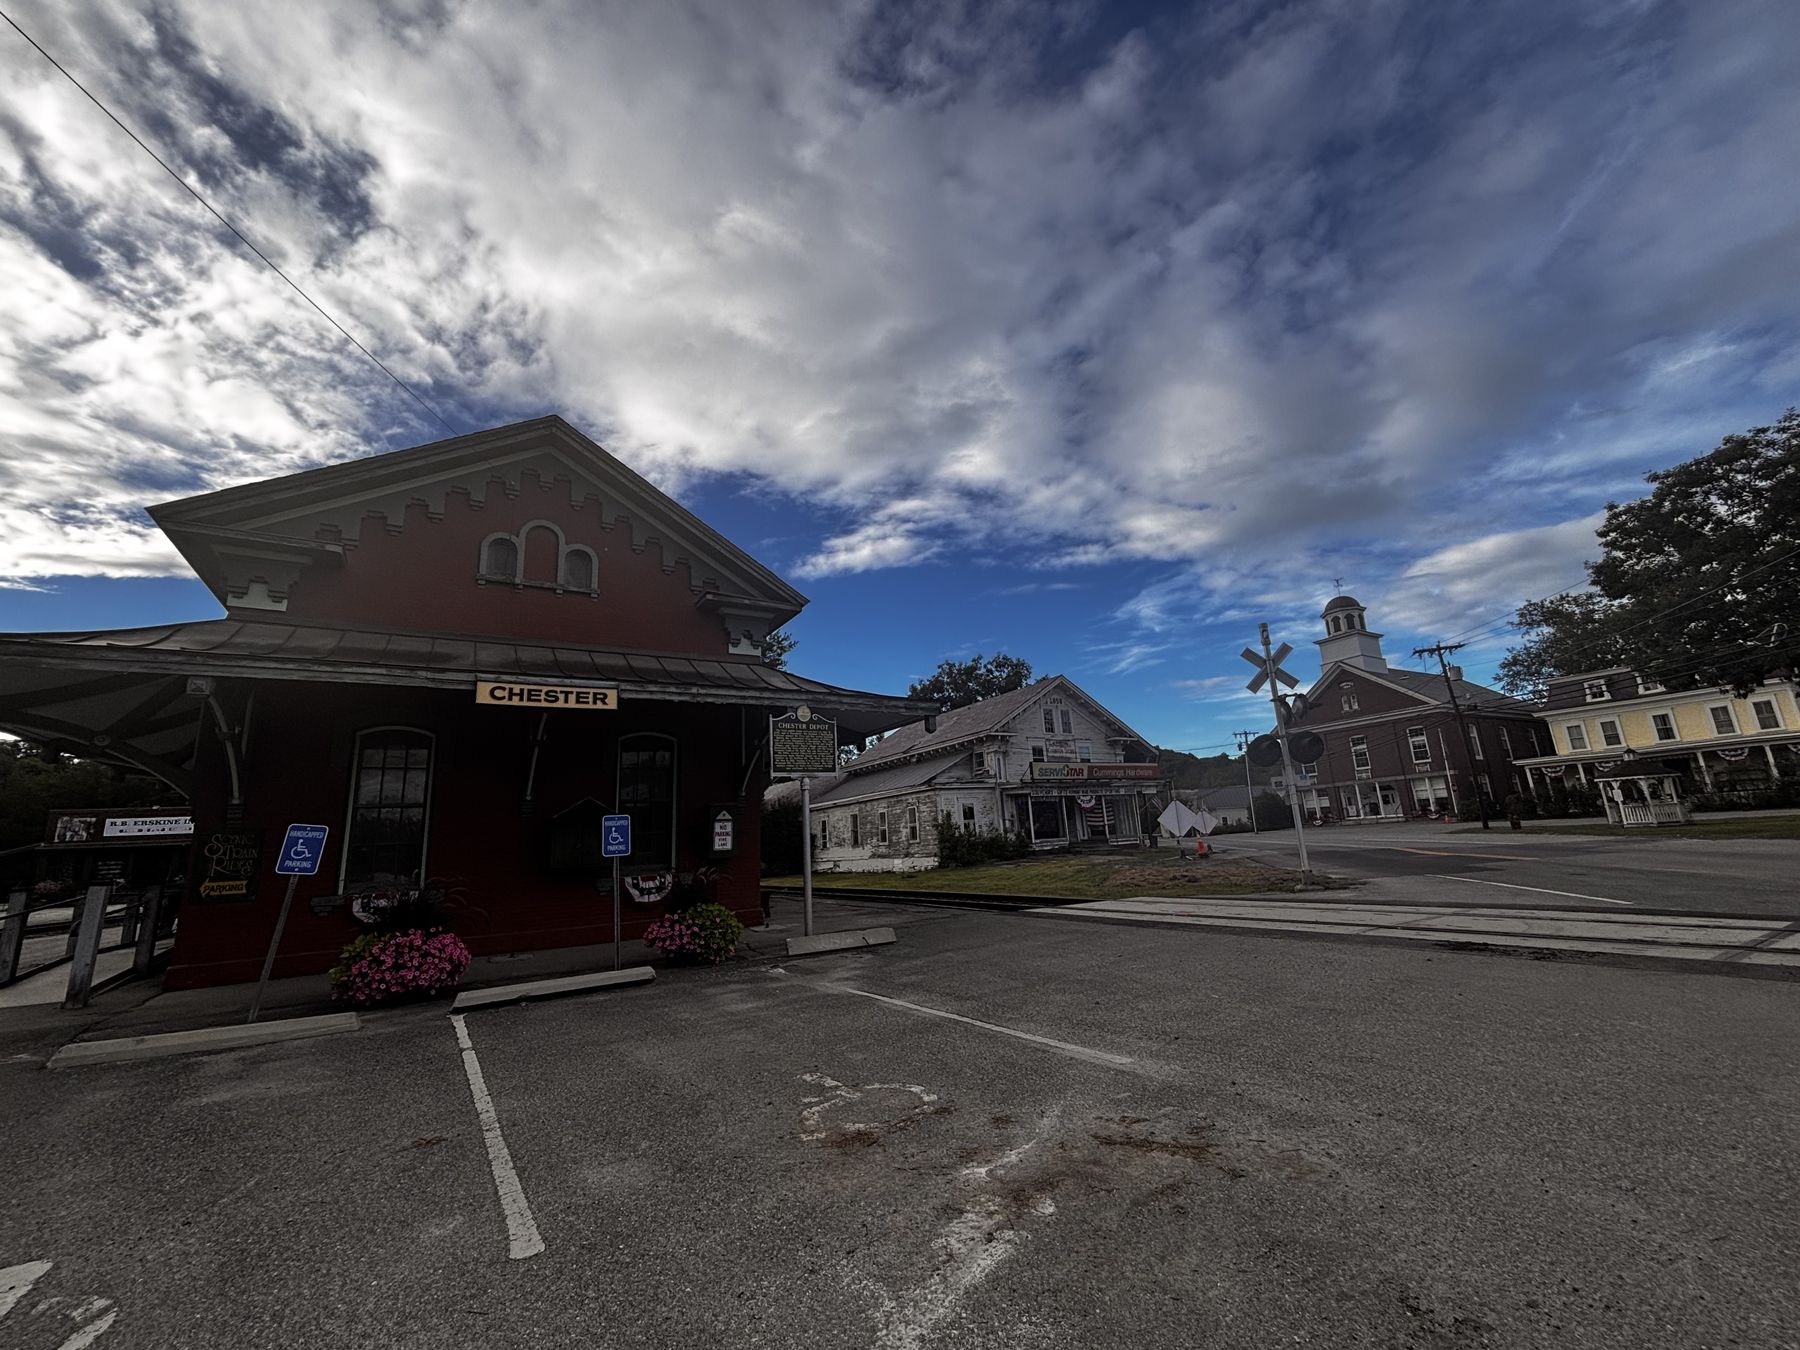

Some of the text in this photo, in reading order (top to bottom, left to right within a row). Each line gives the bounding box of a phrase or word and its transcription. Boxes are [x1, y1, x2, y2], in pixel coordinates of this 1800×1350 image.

[489, 686, 608, 705] CHESTER
[778, 722, 807, 730] CHESTER
[1093, 767, 1124, 778] Cummings
[133, 819, 181, 827] ERSKINE
[289, 830, 324, 839] HANDICAPPED
[284, 860, 312, 868] PARKING
[204, 883, 244, 893] PARKING
